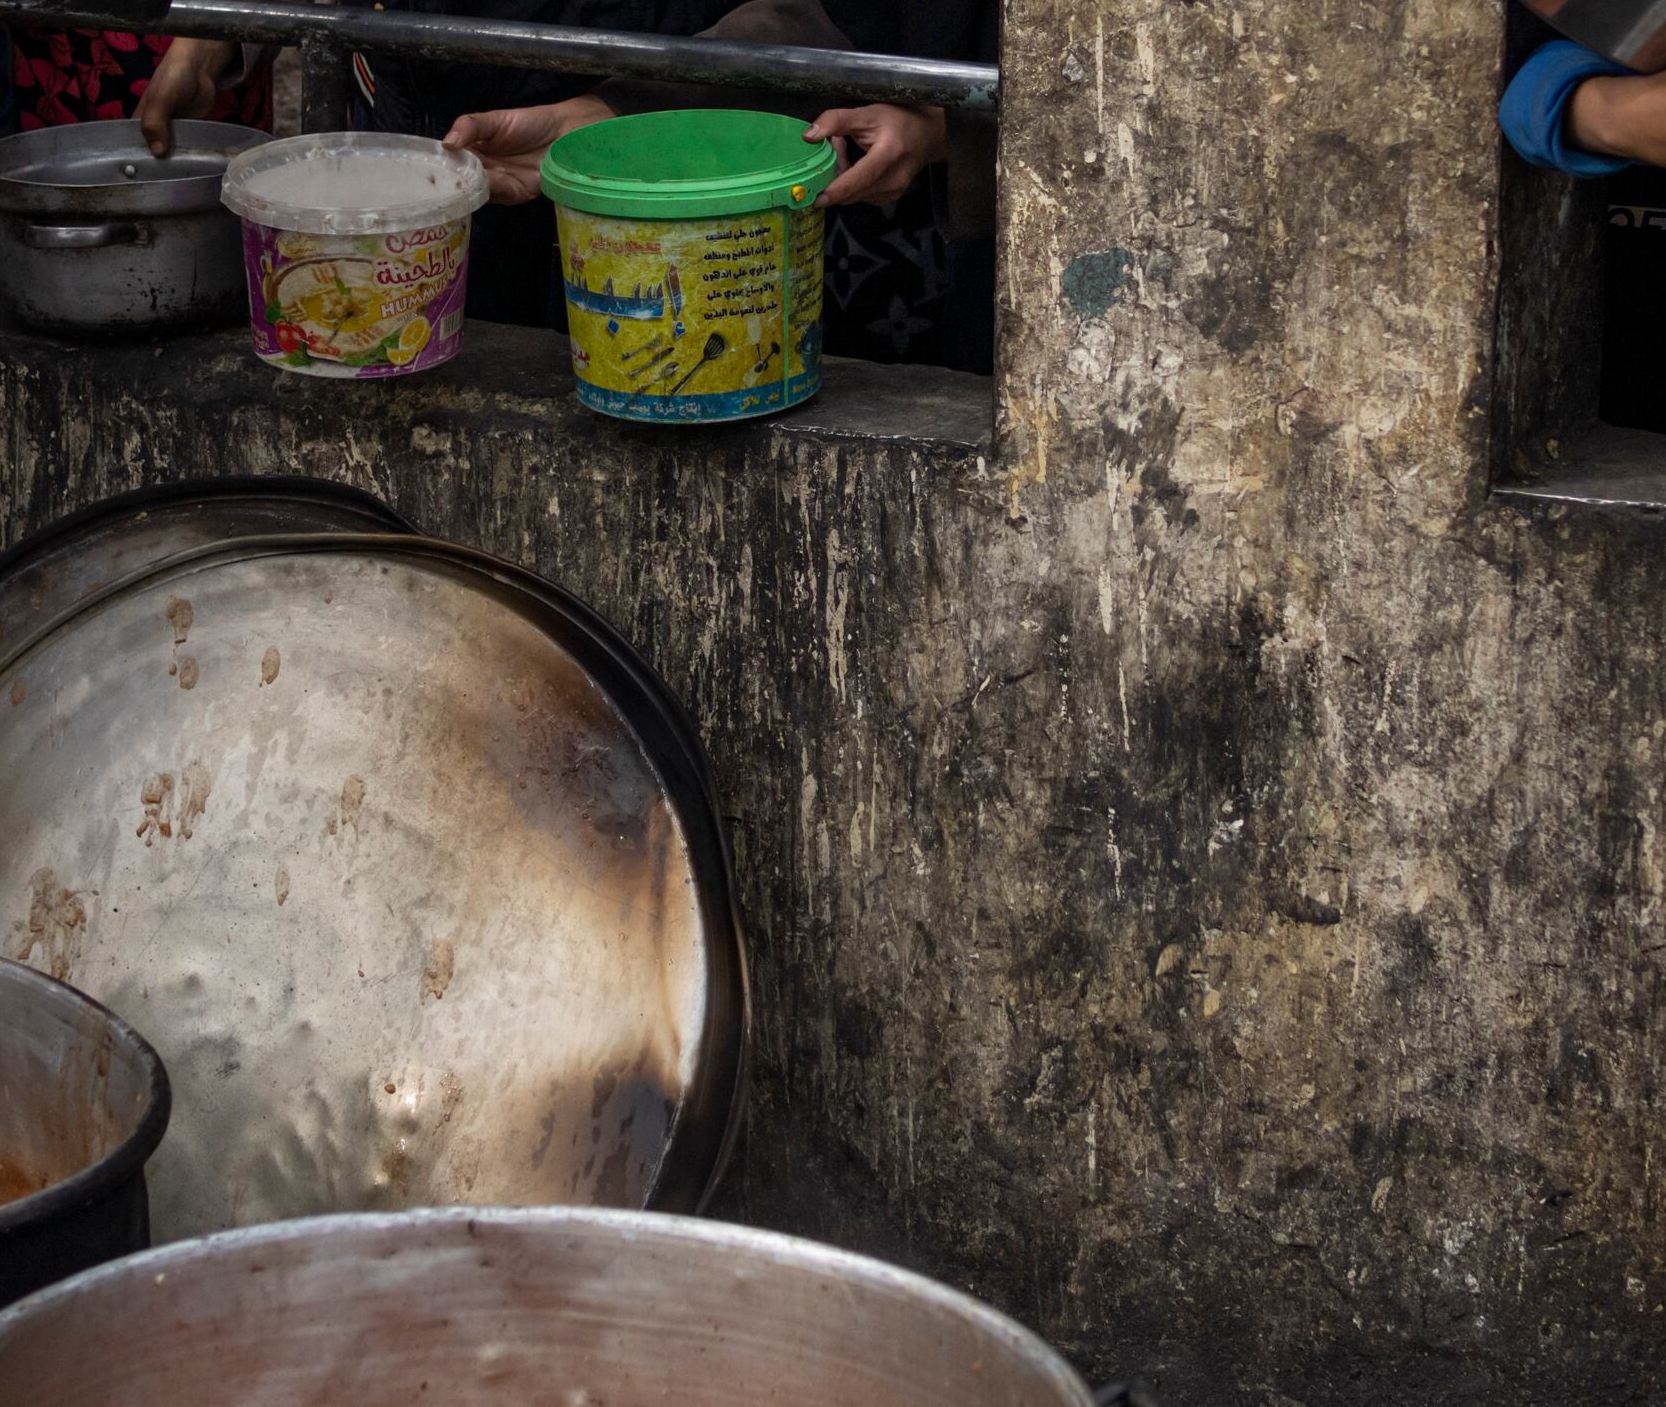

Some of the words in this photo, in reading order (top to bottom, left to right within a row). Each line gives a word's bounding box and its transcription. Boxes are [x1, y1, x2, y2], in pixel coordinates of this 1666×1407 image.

[748, 226, 771, 238] معجون
[377, 247, 455, 289] بالطحينة
[702, 269, 732, 282] الدهون
[380, 275, 449, 320] HUMMUS
